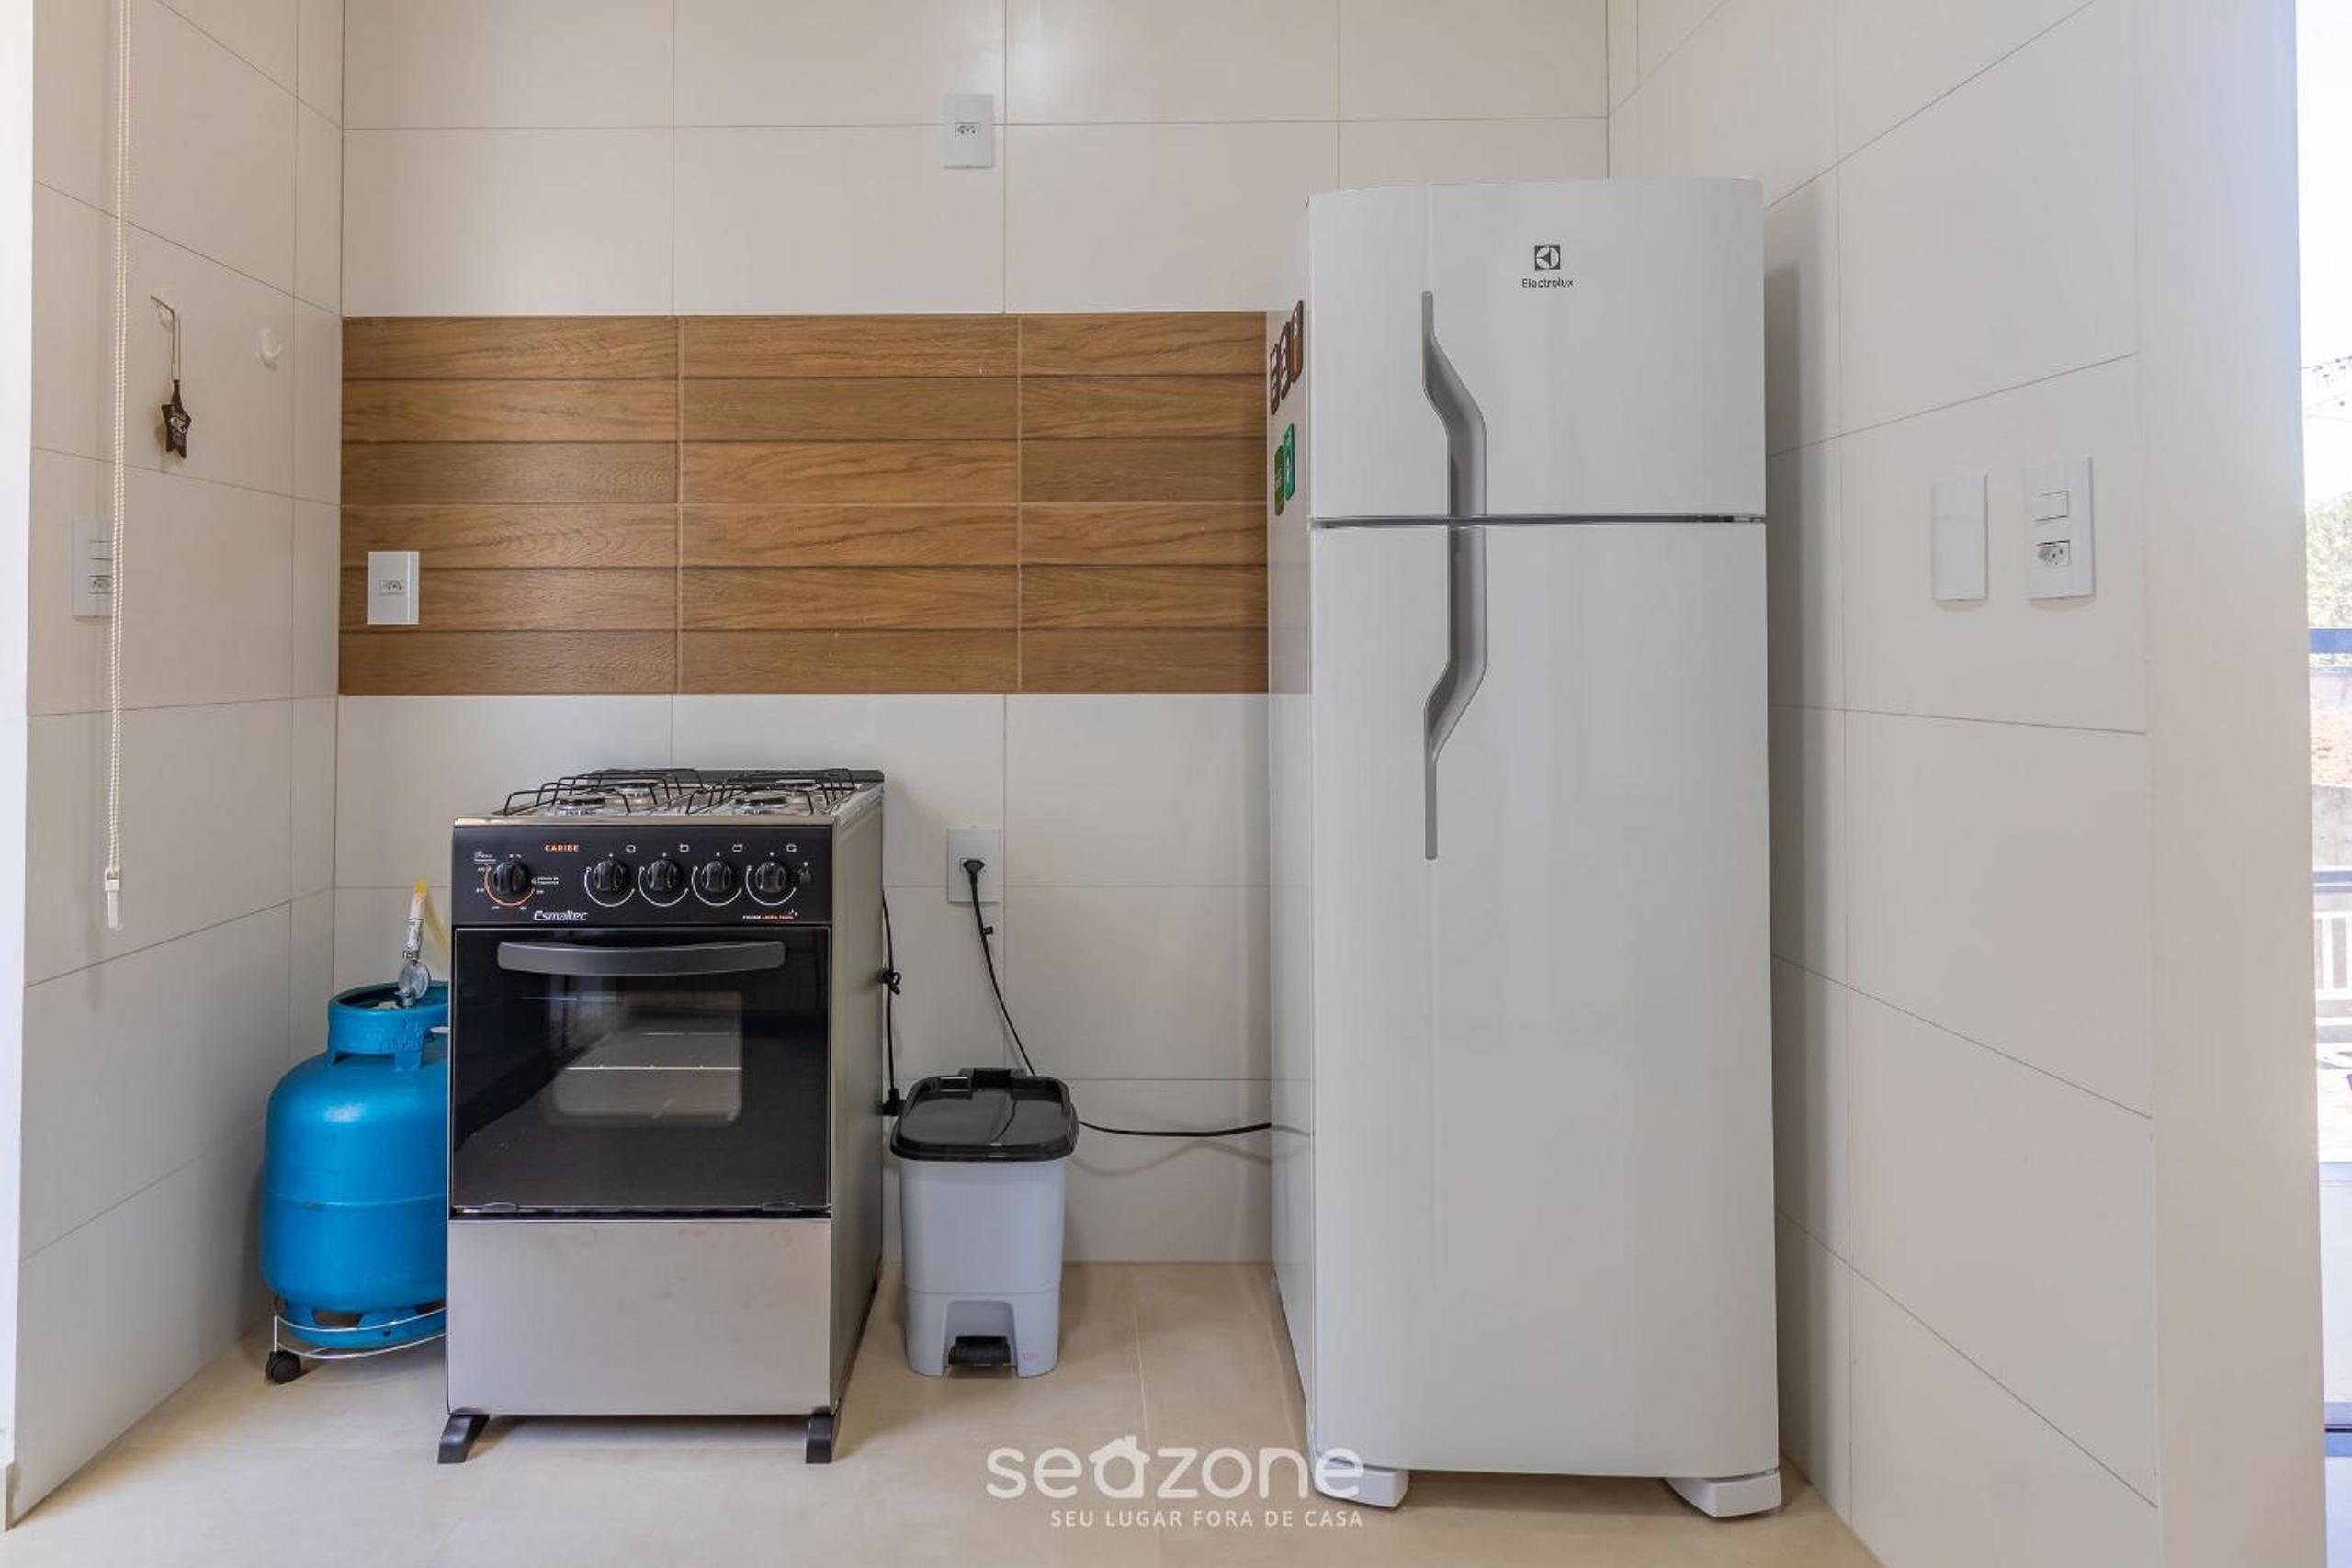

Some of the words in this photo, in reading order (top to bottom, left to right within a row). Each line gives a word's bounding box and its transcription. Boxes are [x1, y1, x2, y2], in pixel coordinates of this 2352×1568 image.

[1521, 277, 1574, 288] Electrolux
[544, 844, 580, 852] CARIBE
[533, 910, 589, 921] Esmaltec
